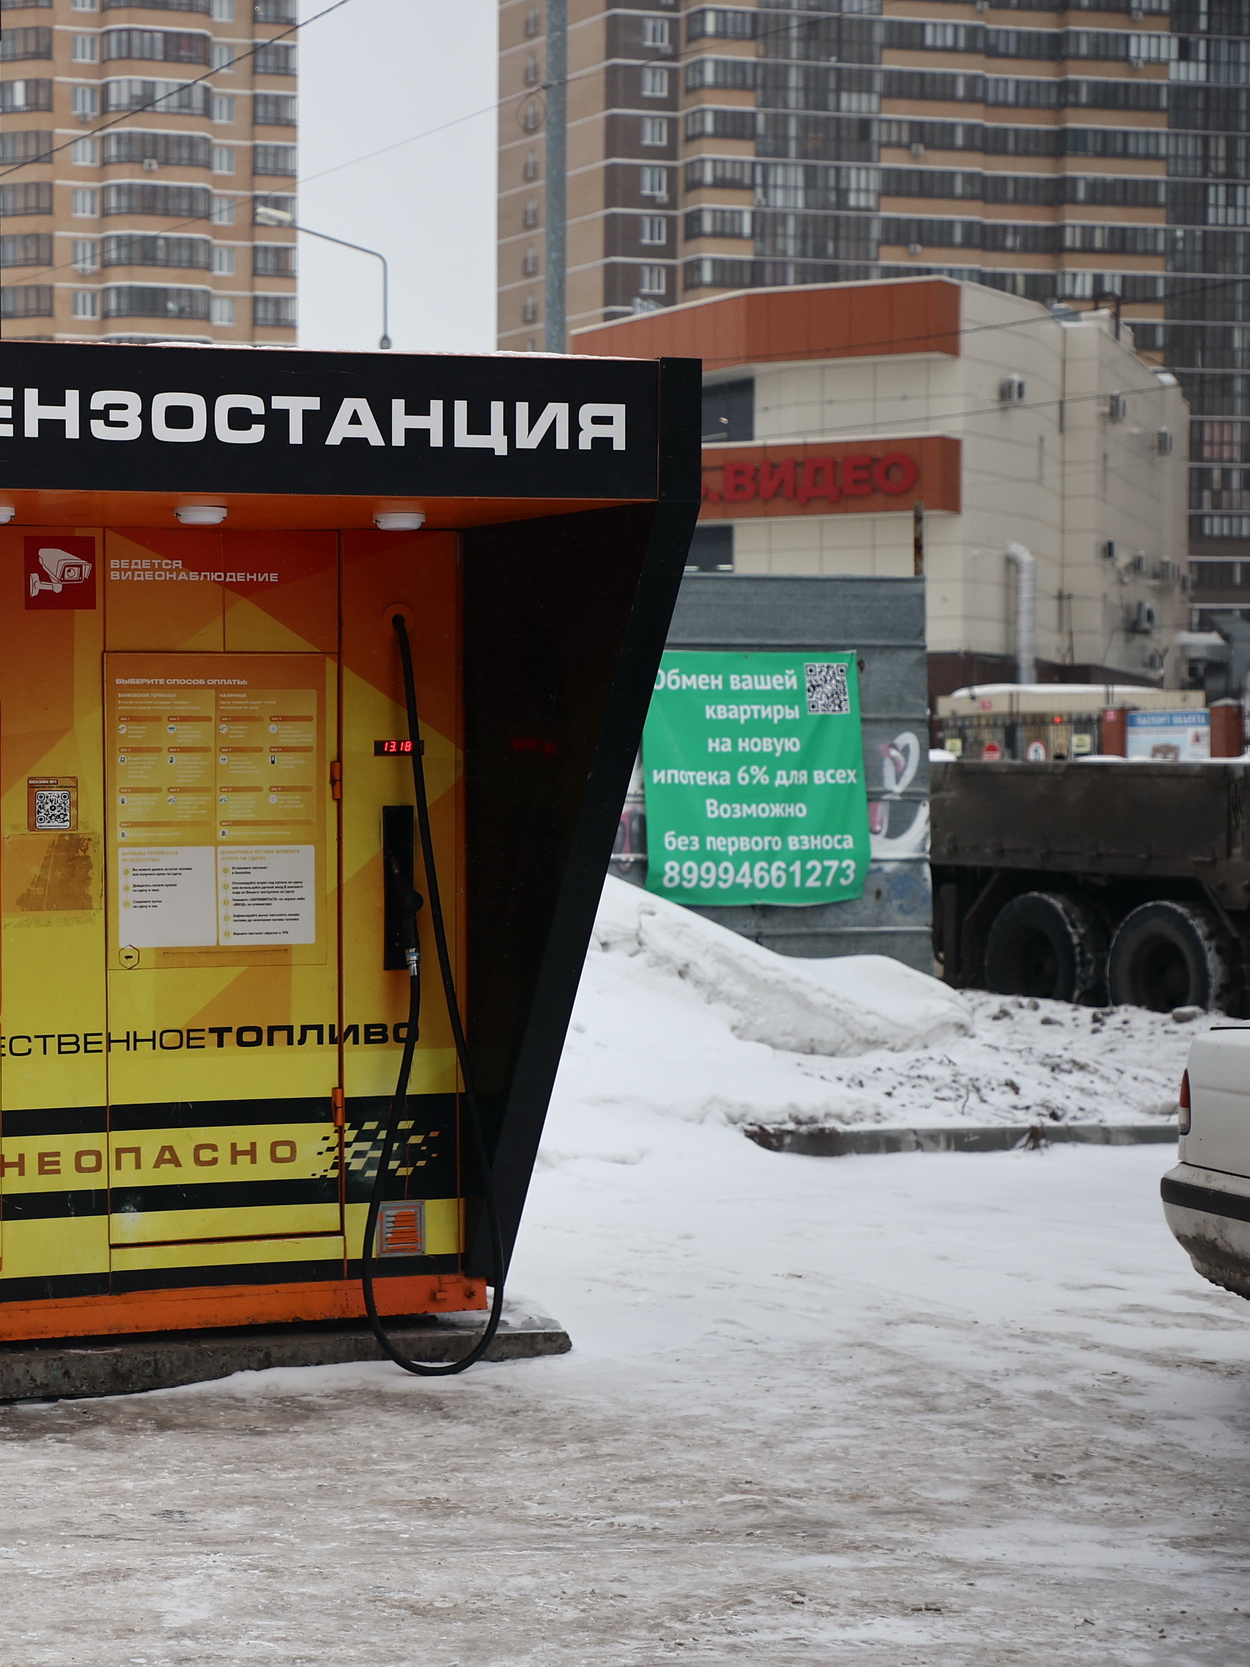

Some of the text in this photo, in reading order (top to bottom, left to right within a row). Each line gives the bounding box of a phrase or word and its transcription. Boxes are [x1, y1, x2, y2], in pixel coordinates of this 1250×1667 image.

[701, 453, 919, 504] .ВИДЕО
[110, 559, 183, 569] ВЕДЕТСЯ
[110, 571, 279, 582] ВИДЕОНАБЛЮДЕНИЕ
[653, 669, 798, 690] Обмен вашей
[705, 703, 800, 724] квартиры
[707, 737, 801, 757] на новую
[652, 767, 858, 788] ипотека 6% для всех
[705, 799, 807, 819] Возможно
[664, 830, 854, 856] без первого взноса
[662, 859, 857, 890] 89994661273
